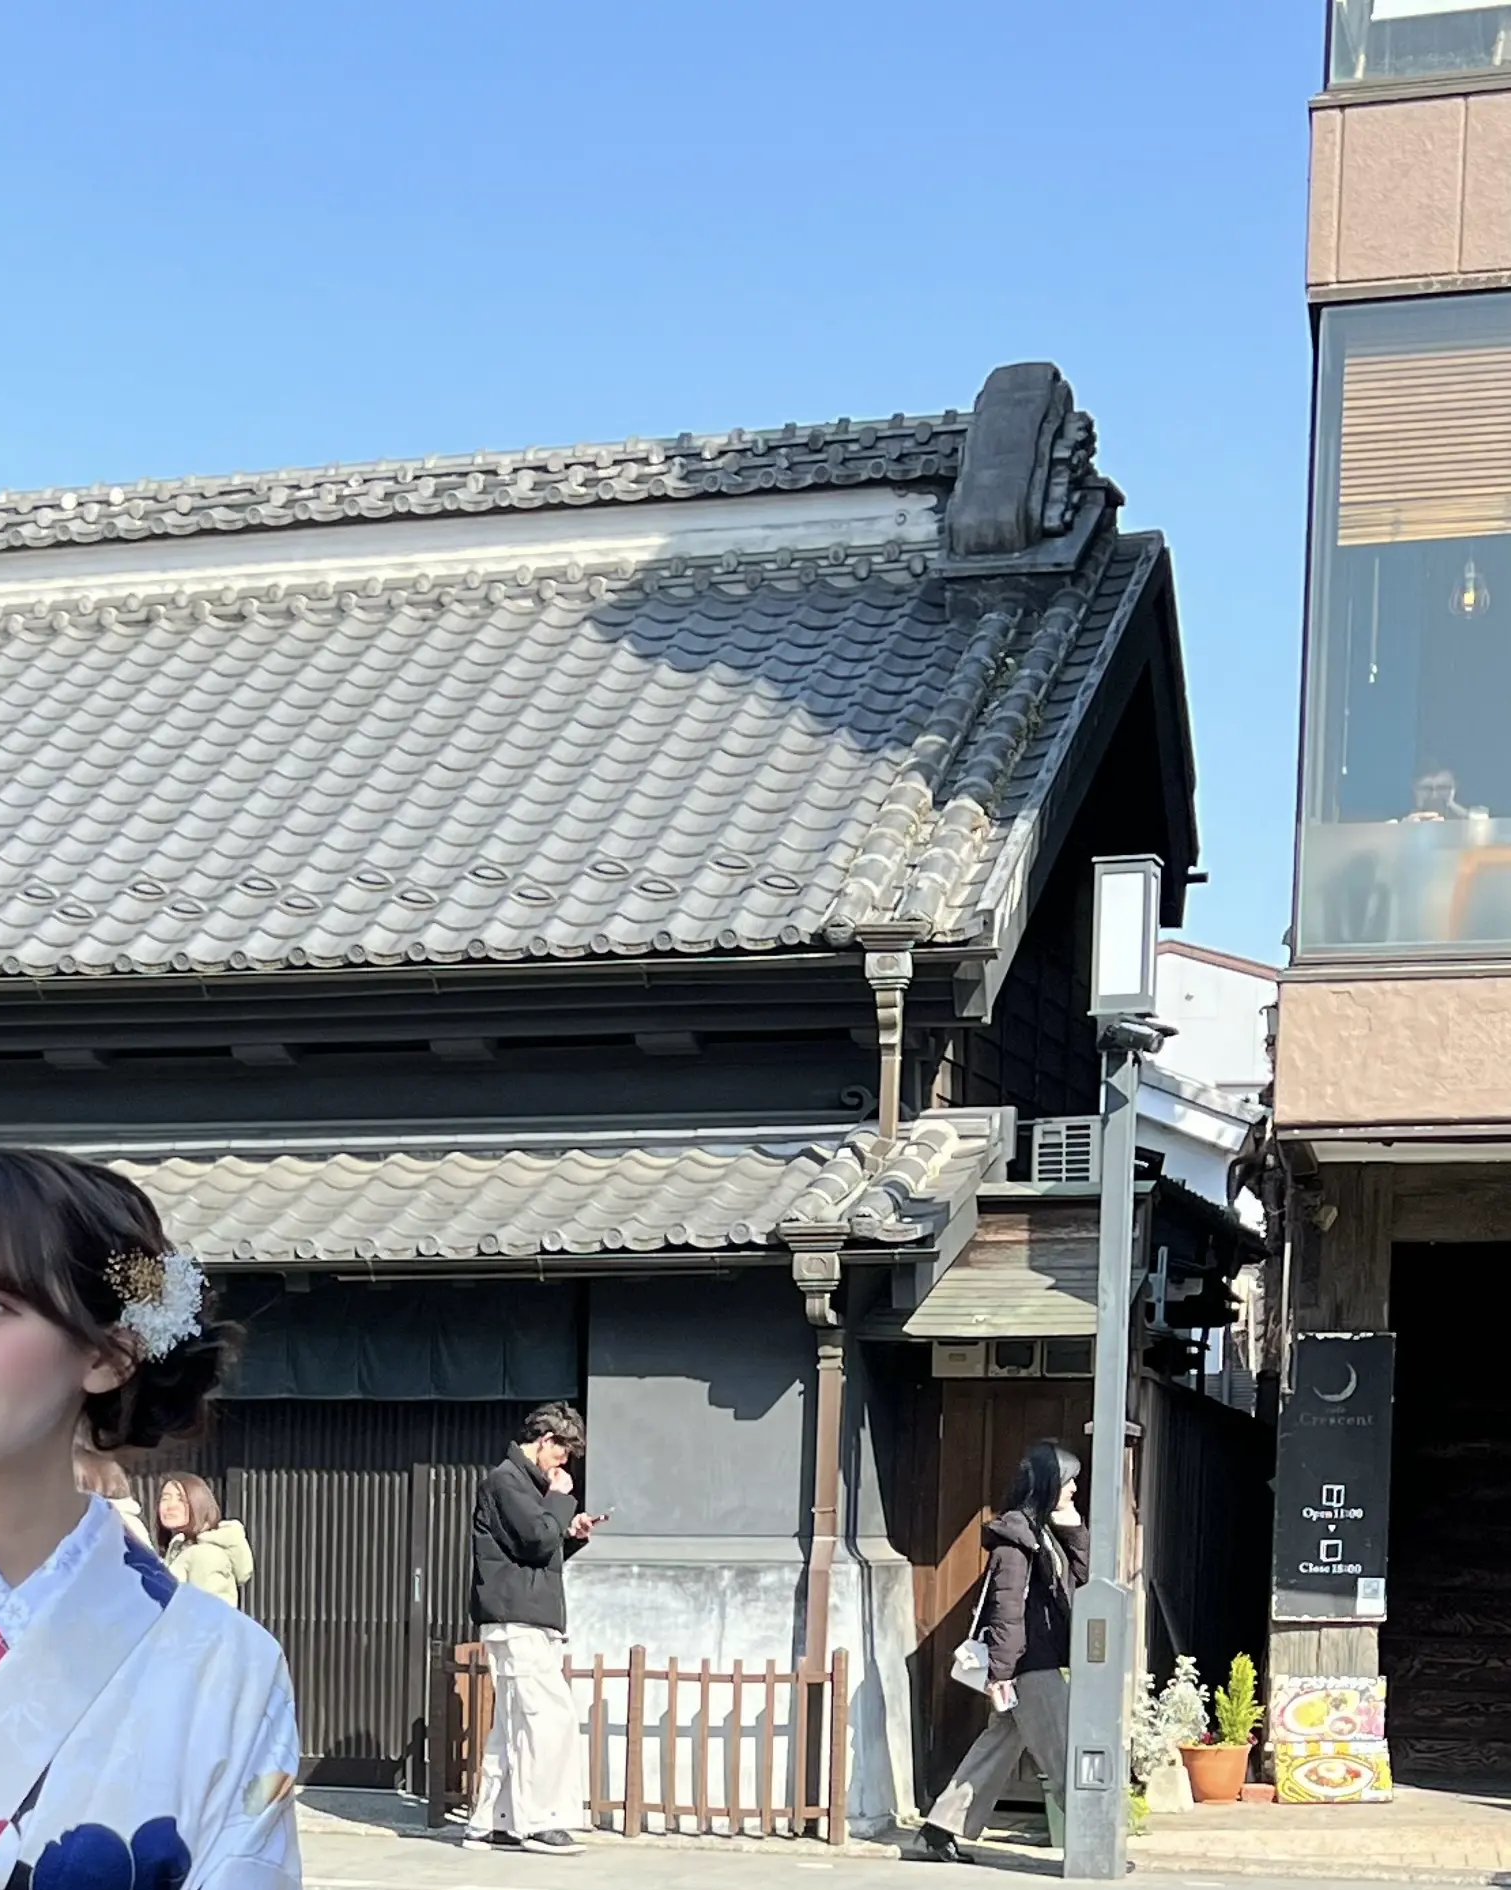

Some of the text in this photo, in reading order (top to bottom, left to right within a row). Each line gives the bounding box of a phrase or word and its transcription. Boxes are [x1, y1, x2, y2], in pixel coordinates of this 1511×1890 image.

[1299, 1411, 1374, 1426] Crescent
[1302, 1507, 1333, 1521] Open
[1298, 1562, 1330, 1574] Close
